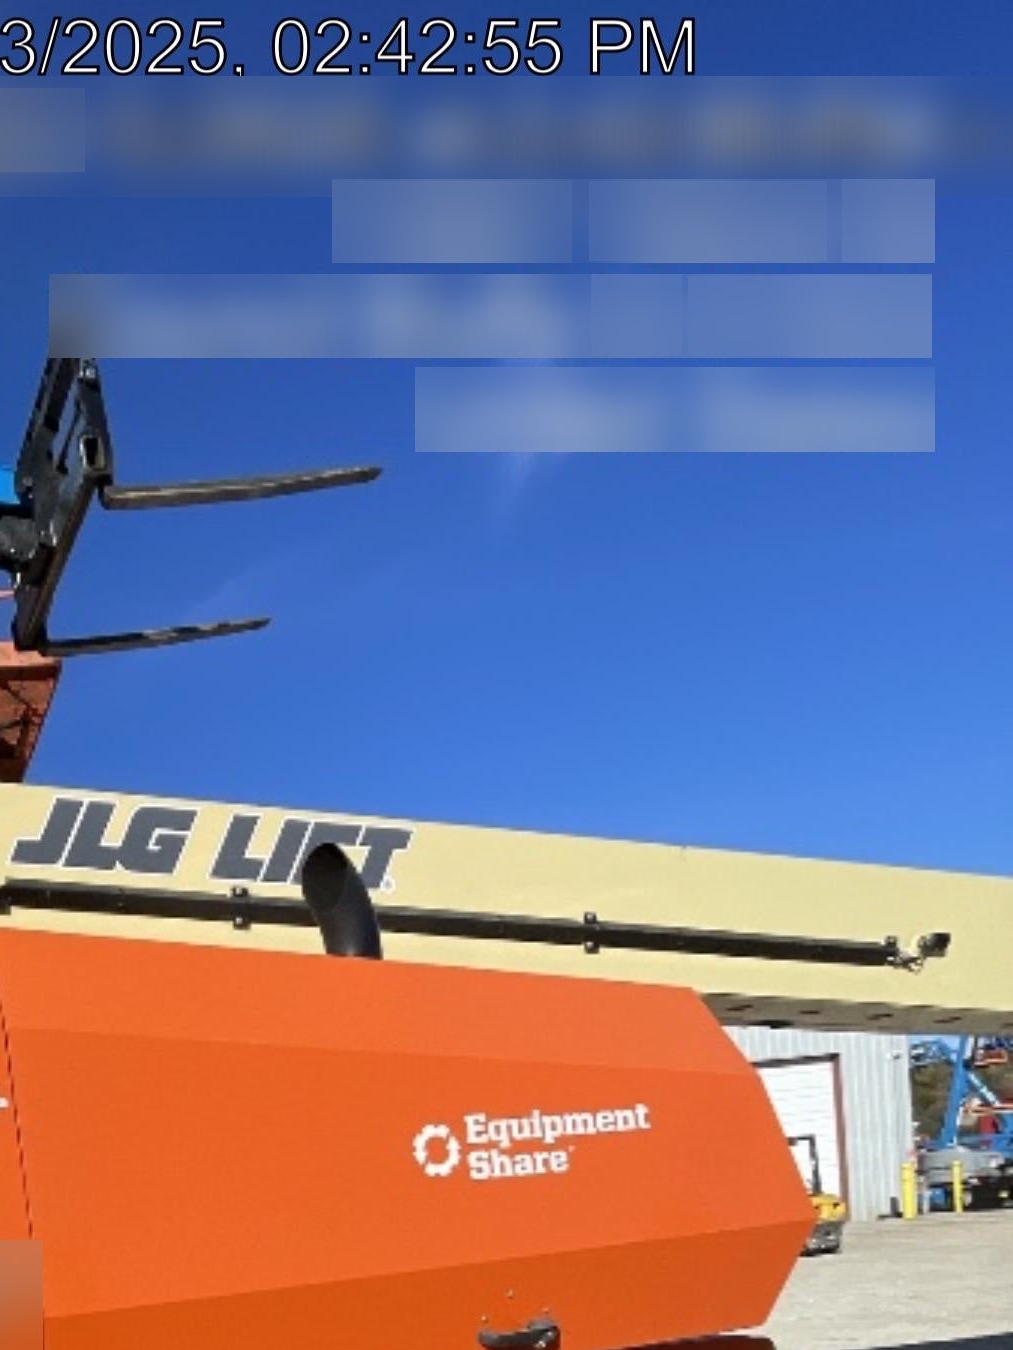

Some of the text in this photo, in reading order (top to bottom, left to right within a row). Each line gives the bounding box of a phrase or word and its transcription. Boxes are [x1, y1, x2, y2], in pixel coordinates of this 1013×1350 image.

[8, 796, 200, 876] JLG
[463, 1103, 651, 1149] Equipment
[466, 1149, 571, 1181] Share
